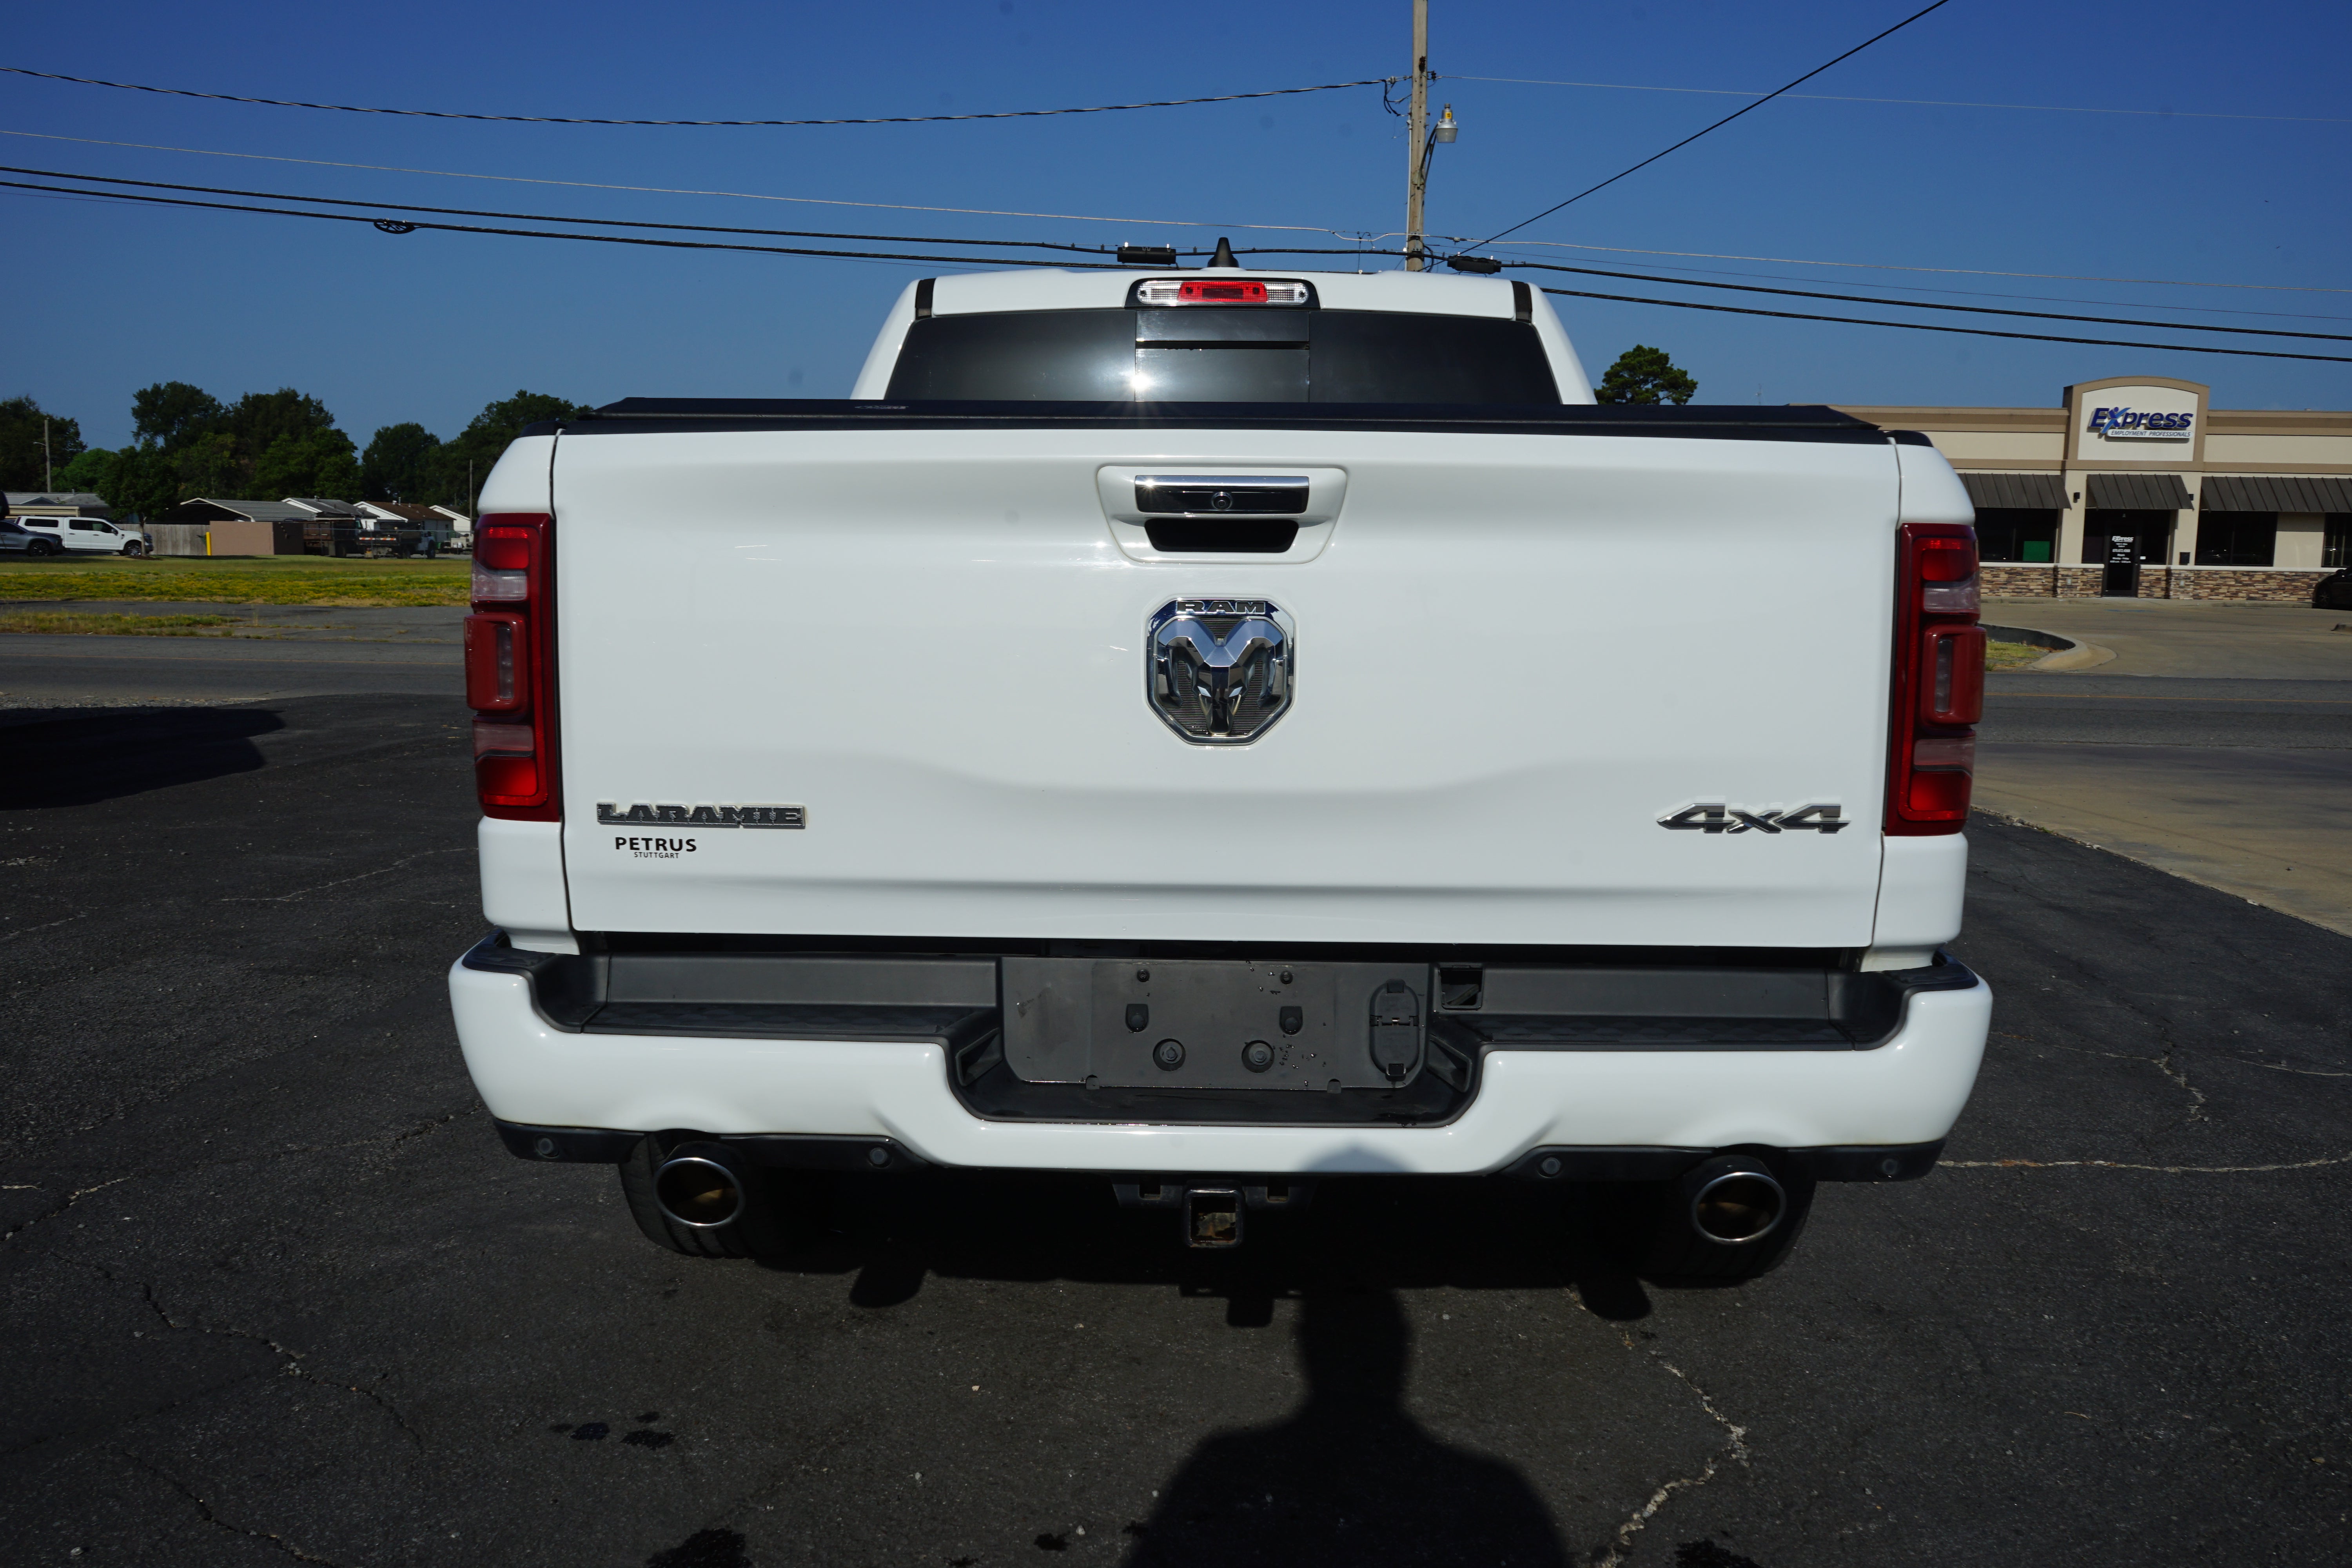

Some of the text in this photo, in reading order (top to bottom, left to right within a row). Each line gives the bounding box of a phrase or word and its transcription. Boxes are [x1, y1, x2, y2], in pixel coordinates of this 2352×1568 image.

[1176, 601, 1265, 614] RAM
[597, 802, 806, 829] LARAMIE
[615, 837, 697, 852] PETRUS
